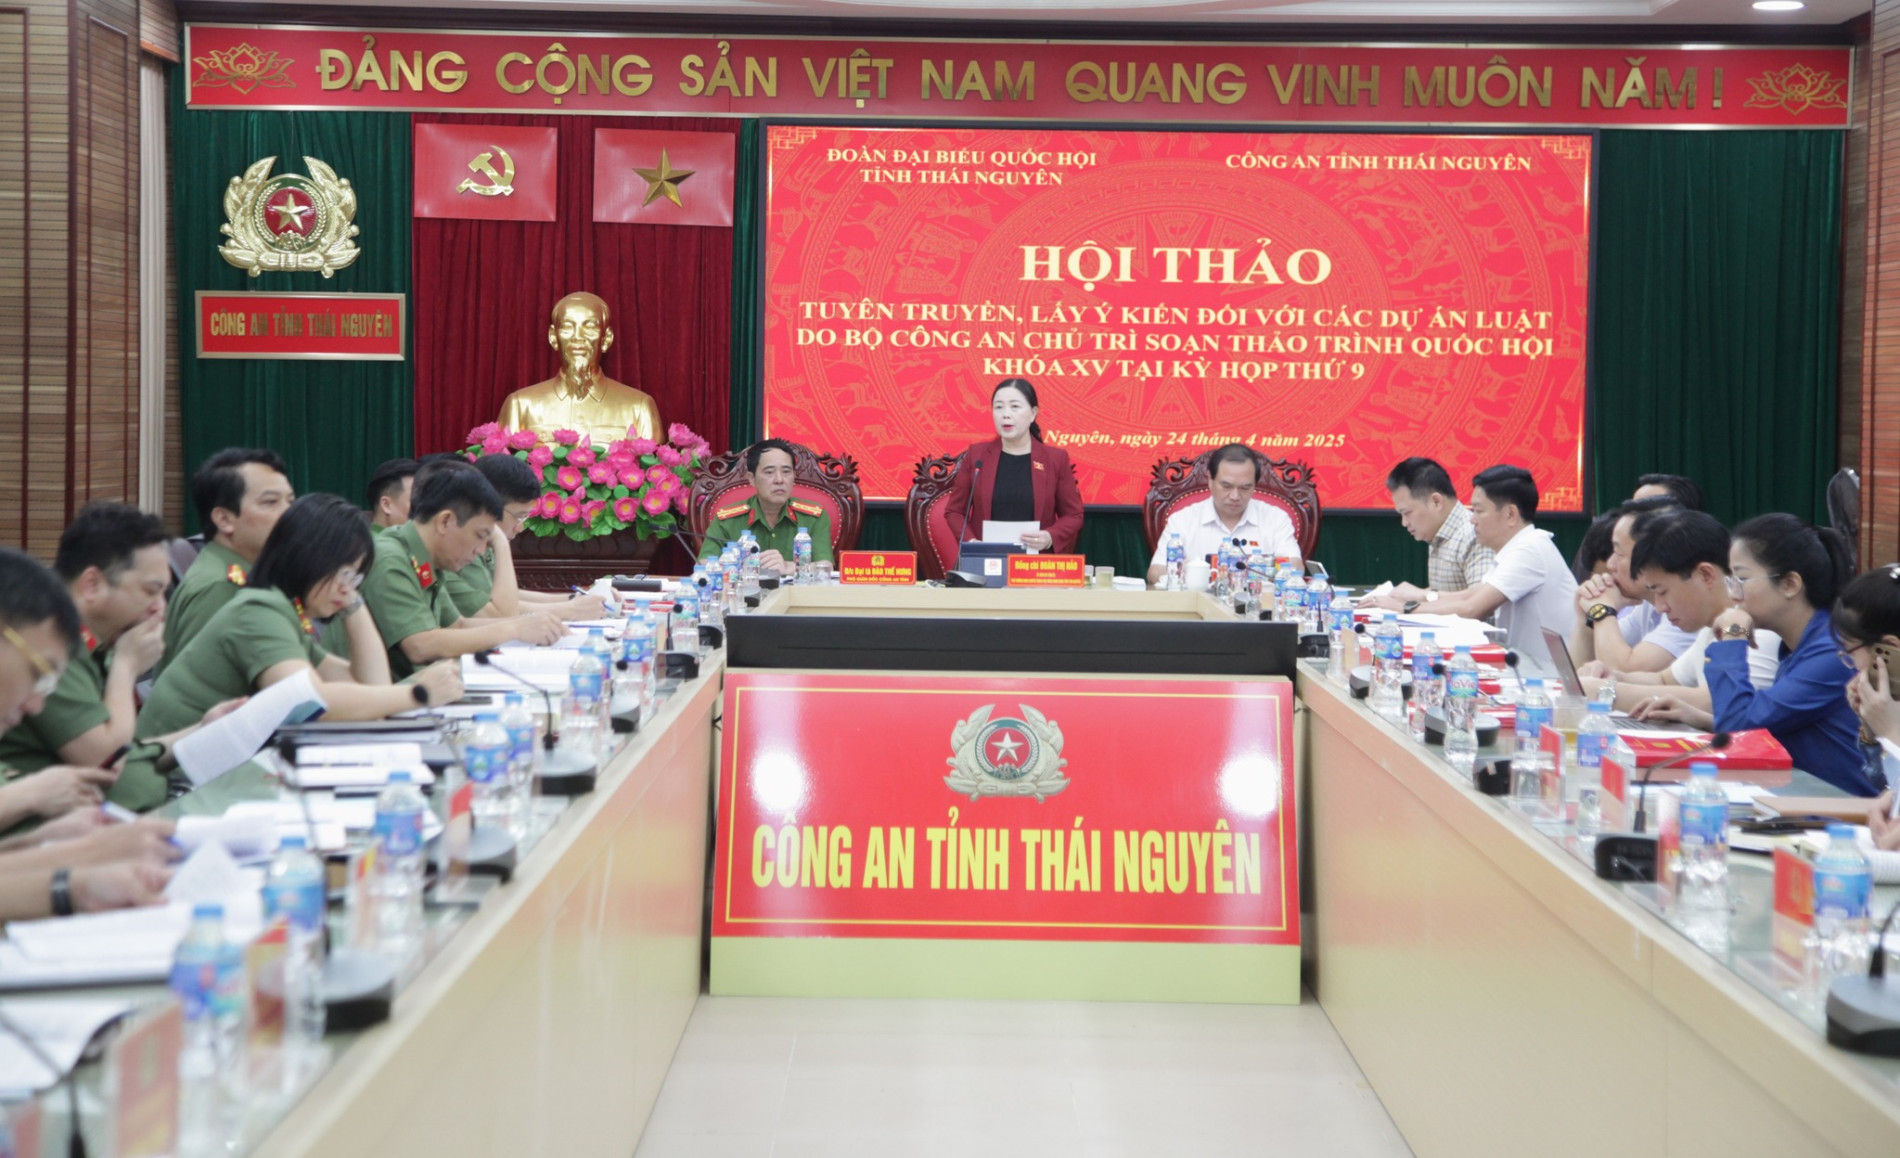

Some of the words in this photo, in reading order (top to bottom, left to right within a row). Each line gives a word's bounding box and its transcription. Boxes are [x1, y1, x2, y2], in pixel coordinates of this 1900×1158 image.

[317, 36, 467, 93] ĐẢNG
[496, 43, 653, 104] CỘNG
[680, 42, 777, 98] SẢN
[801, 48, 893, 108] VIỆT
[921, 59, 1034, 100] NAM
[1066, 62, 1247, 104] QUANG
[1267, 64, 1379, 105] VINH
[1404, 55, 1553, 107] MUÔN
[1581, 57, 1698, 108] NĂM
[1713, 68, 1722, 108] !
[828, 146, 885, 161] ĐOÀN
[894, 150, 928, 166] ĐẠI
[937, 147, 984, 164] BIỂU
[991, 148, 1051, 166] QUỐC
[1058, 151, 1095, 168] HỘI
[1226, 152, 1286, 168] CÔNG
[1293, 156, 1321, 168] AN
[1330, 151, 1377, 169] TỈNH
[1384, 153, 1435, 169] THÁI
[1443, 154, 1530, 170] NGUYÊN
[860, 167, 910, 182] TỈNH
[921, 168, 968, 183] THÁI
[976, 169, 1061, 184] NGUYÊN
[1020, 240, 1136, 291] HỘI
[1154, 238, 1331, 284] THẢO
[211, 308, 245, 336] CÔNG
[251, 313, 268, 336] AN
[273, 305, 303, 336] TỈNH
[308, 308, 336, 336] THÁI
[341, 309, 393, 337] NGUYÊN
[800, 298, 893, 319] TUYÊN
[902, 298, 1023, 324] TRUYỀN,
[1032, 299, 1087, 322] LẤY
[1095, 302, 1112, 323] Ý
[1122, 304, 1188, 323] KIẾN
[1199, 304, 1246, 325] ĐỐI
[1256, 305, 1304, 326] VỚI
[1314, 305, 1372, 326] CÁC
[1381, 309, 1422, 331] DỰ
[1430, 306, 1466, 327] ÁN
[1477, 308, 1551, 334] LUẬT
[798, 329, 836, 345] DO
[845, 327, 882, 350] BỘ
[891, 325, 970, 347] CÔNG
[977, 332, 1014, 348] AN
[1024, 328, 1082, 349] CHỦ
[1090, 329, 1136, 350] TRÌ
[1146, 335, 1219, 355] SOẠN
[1228, 332, 1307, 352] THẢO
[1315, 332, 1402, 353] TRÌNH
[1412, 334, 1492, 357] QUỐC
[1503, 336, 1552, 359] HỘI
[984, 354, 1064, 375] KHÓA
[1072, 360, 1109, 376] XV
[1117, 360, 1162, 381] TẠI
[1174, 355, 1211, 377] KỲ
[1221, 362, 1278, 382] HỌP
[1284, 358, 1345, 379] THỨ
[1352, 363, 1364, 379] 9
[1121, 432, 1161, 447] ngày
[1167, 432, 1187, 444] 24
[1192, 433, 1241, 445] tháng
[1246, 434, 1256, 445] 4
[1261, 435, 1298, 446] năm
[1305, 434, 1344, 447] 2025
[752, 814, 852, 888] CÔNG
[863, 827, 915, 888] AN
[926, 806, 1009, 890] TỈNH
[1021, 816, 1101, 891] THÁI
[1114, 819, 1258, 893] NGUYÊN
